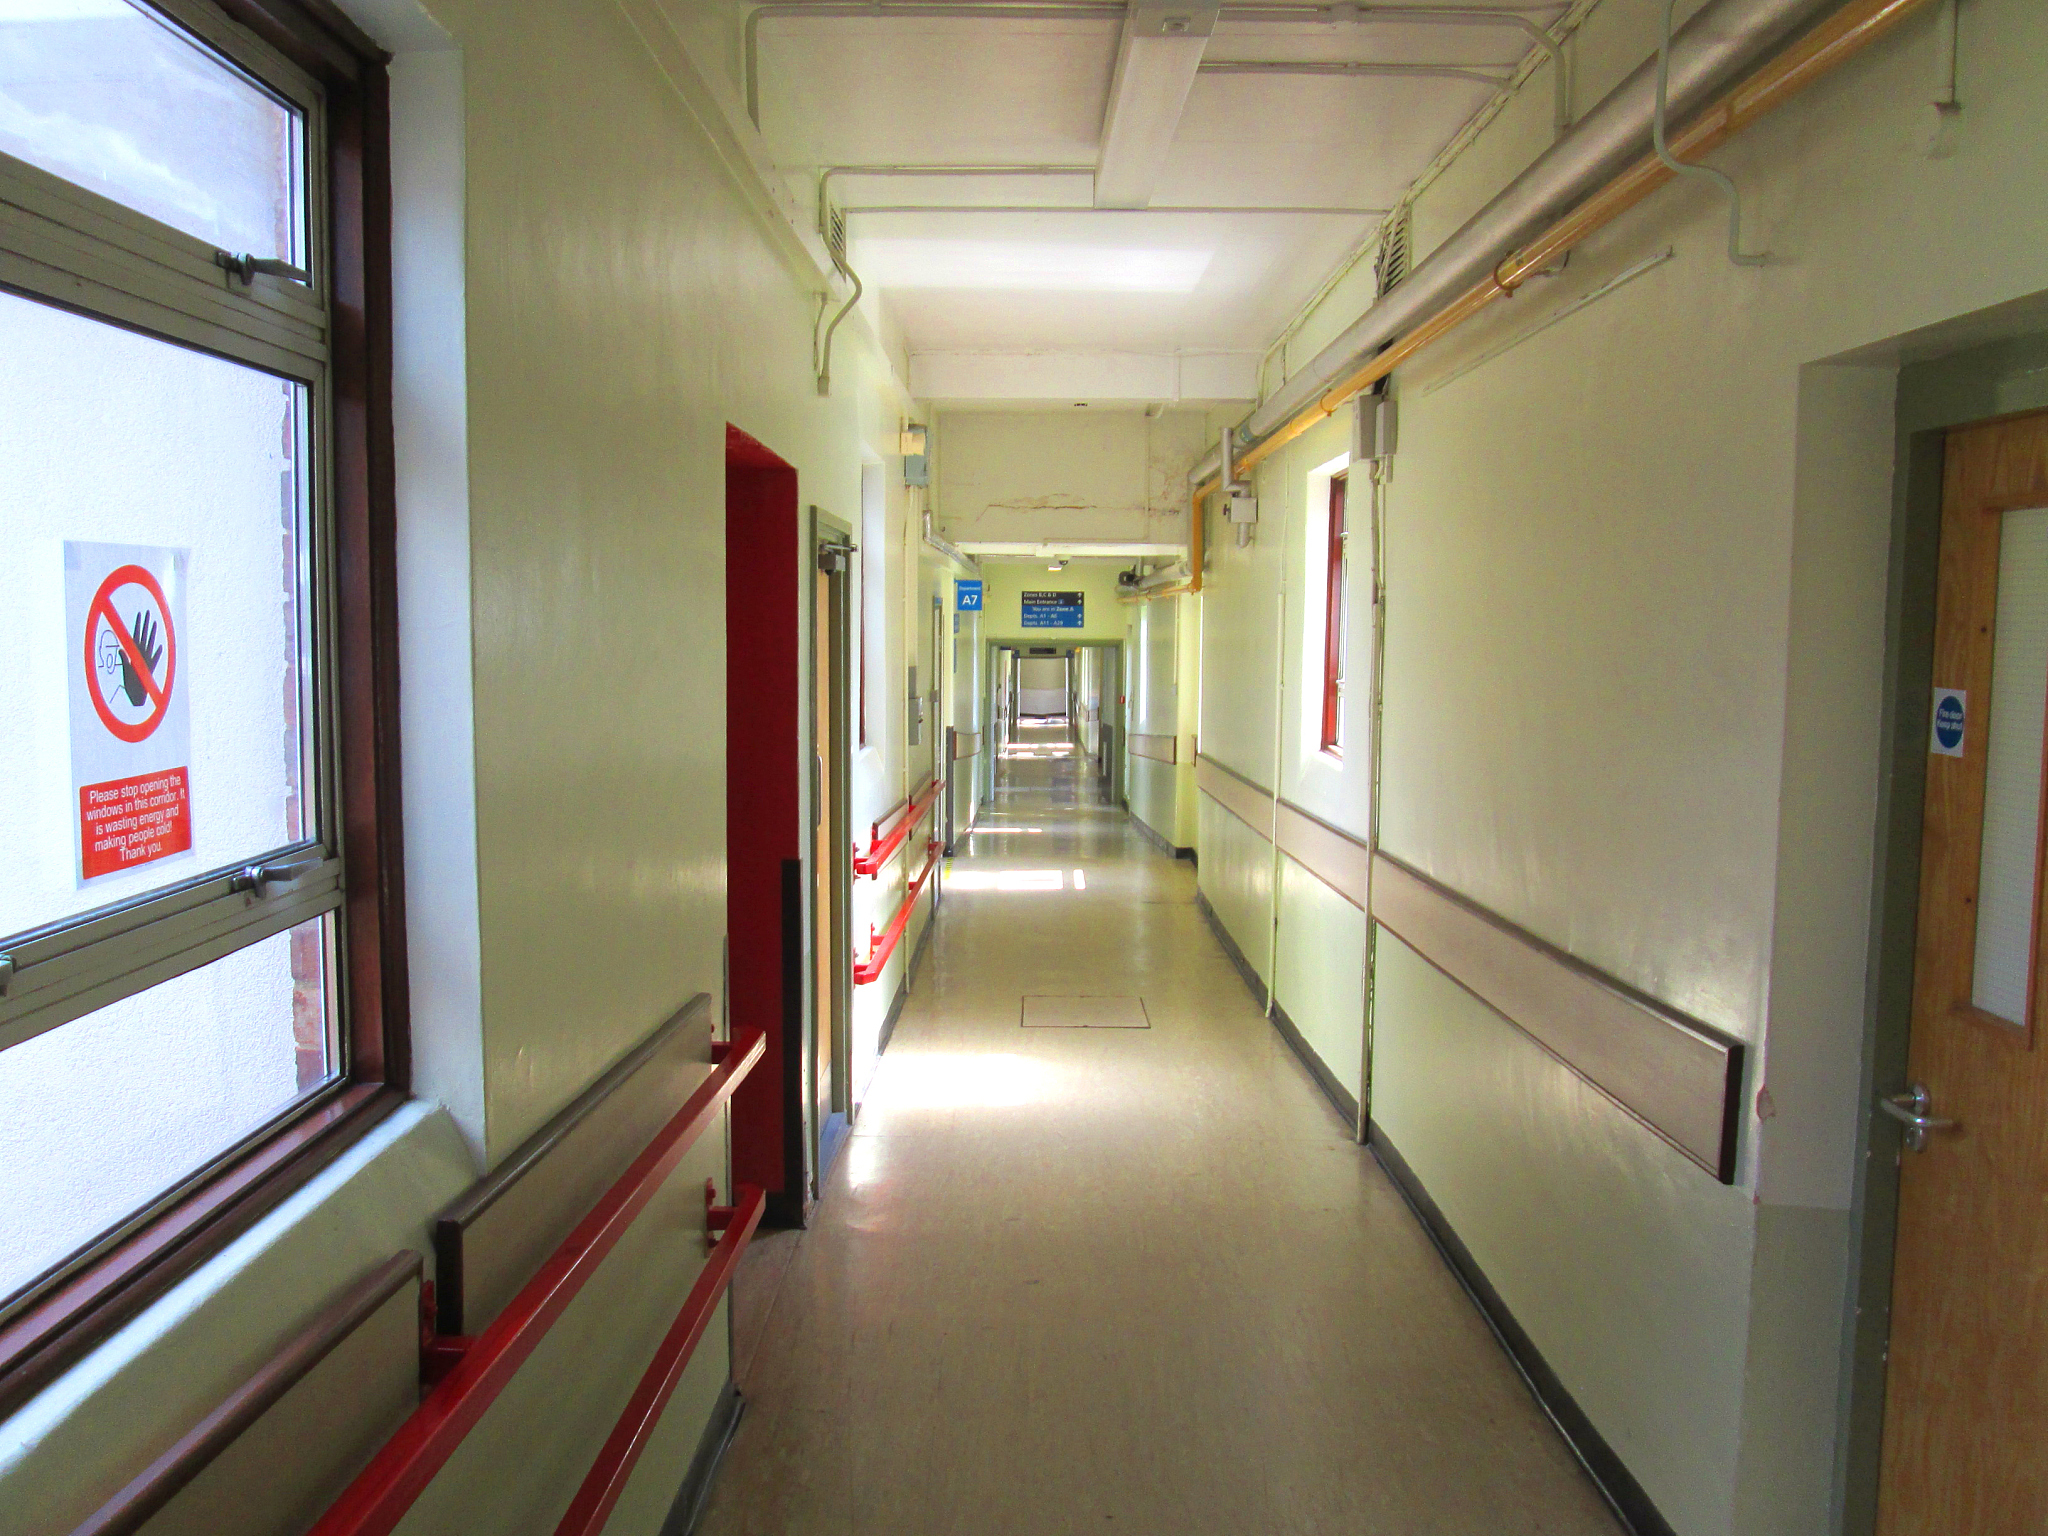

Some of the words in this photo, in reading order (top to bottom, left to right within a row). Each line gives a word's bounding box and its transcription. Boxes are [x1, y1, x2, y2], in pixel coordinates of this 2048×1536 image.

[962, 595, 977, 605] A7
[1940, 709, 1949, 718] Fire
[1950, 711, 1962, 719] door
[1951, 722, 1962, 730] shut
[89, 790, 118, 804] Please
[121, 785, 138, 798] stop
[140, 778, 168, 795] opening
[170, 774, 181, 786] the
[86, 803, 123, 821] windows
[125, 800, 133, 812] in
[135, 796, 148, 810] this
[150, 791, 179, 806] corridor.
[180, 788, 185, 799] It
[96, 823, 103, 835] is
[105, 816, 137, 833] wasting
[140, 810, 165, 825] energy
[165, 804, 179, 817] and
[95, 834, 126, 852] making
[128, 827, 154, 846] people
[156, 820, 172, 836] cold!
[120, 846, 146, 861] Thank
[148, 842, 162, 857] you.
